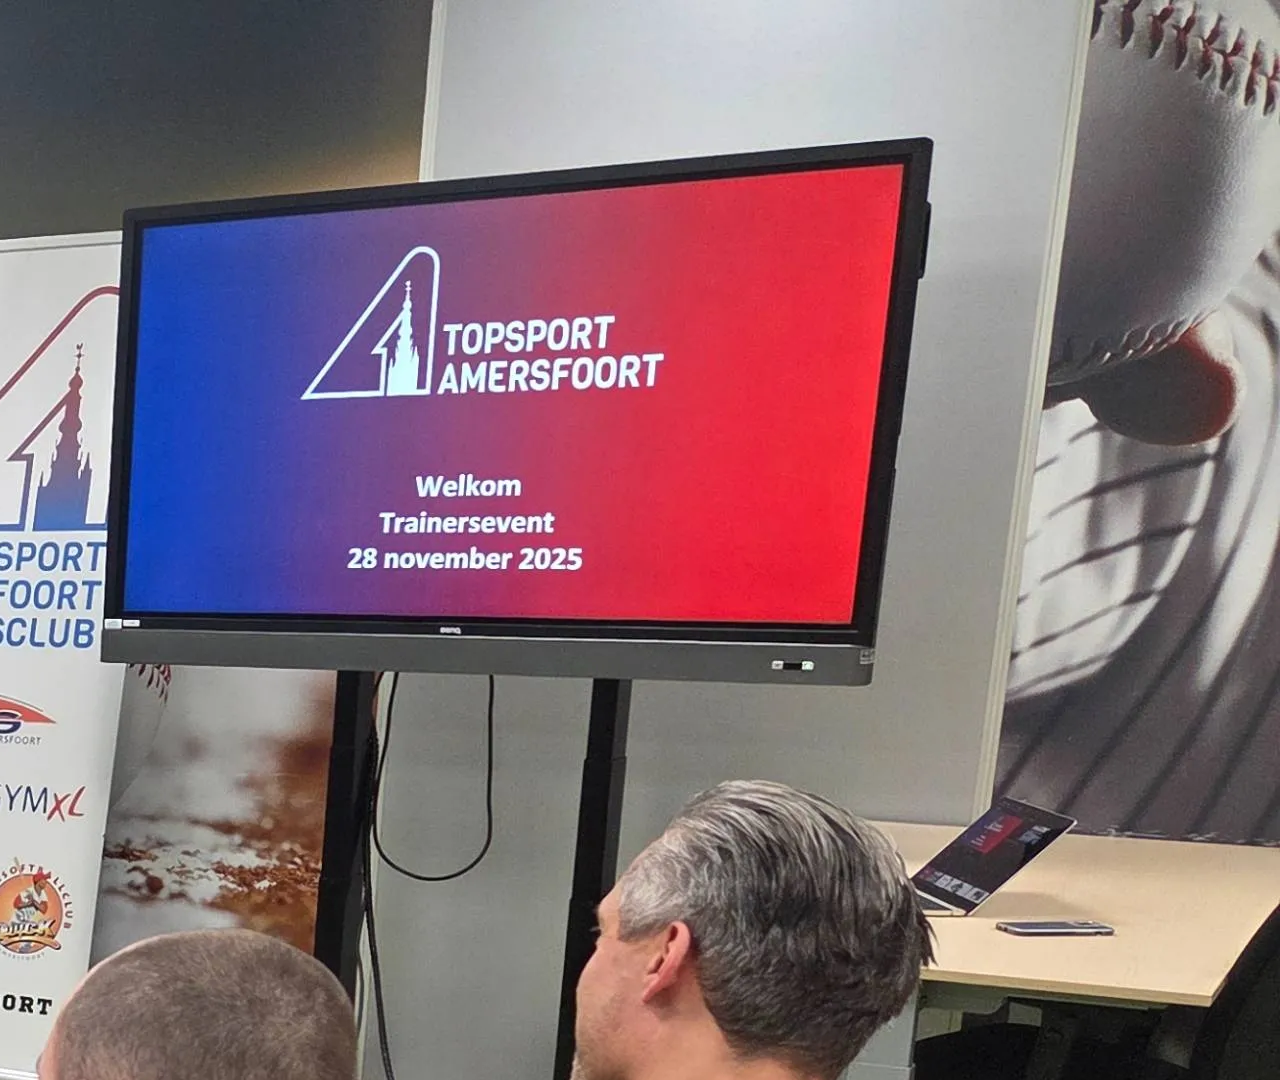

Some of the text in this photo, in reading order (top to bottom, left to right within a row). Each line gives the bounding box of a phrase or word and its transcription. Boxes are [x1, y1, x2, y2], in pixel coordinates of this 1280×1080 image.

[443, 315, 616, 356] TOPSPORT
[437, 353, 665, 395] AMERSFOORT
[415, 474, 522, 498] Welkom
[379, 511, 555, 534] Trainersevent
[347, 547, 583, 570] 28 november 2025
